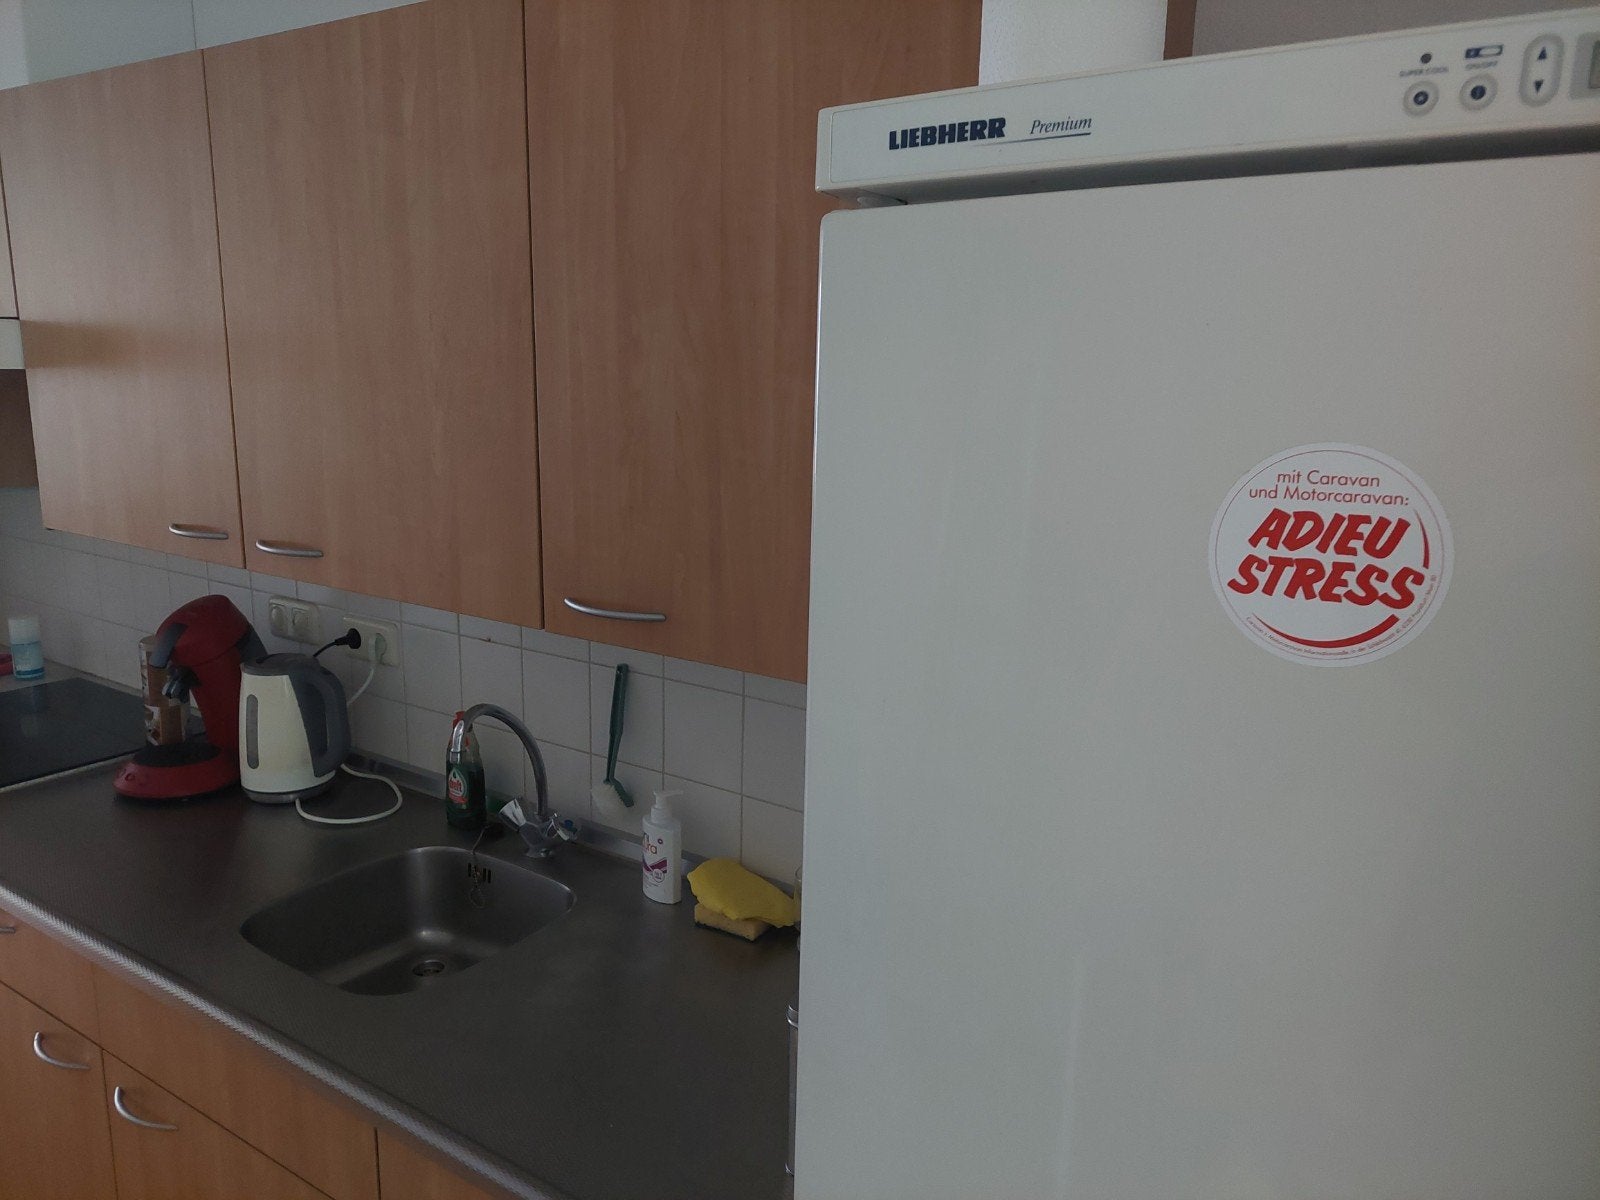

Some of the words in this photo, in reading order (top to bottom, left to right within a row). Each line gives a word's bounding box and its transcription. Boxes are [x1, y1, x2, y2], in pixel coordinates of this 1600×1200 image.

[889, 117, 1006, 150] LIEBHERR
[1030, 115, 1092, 135] Premium
[1249, 485, 1279, 499] und
[1284, 487, 1410, 506] Motorcaravan:
[1277, 470, 1302, 484] mit
[1307, 470, 1380, 487] Caravan
[1248, 508, 1411, 559] ADIEU
[1227, 554, 1425, 609] STRESS
